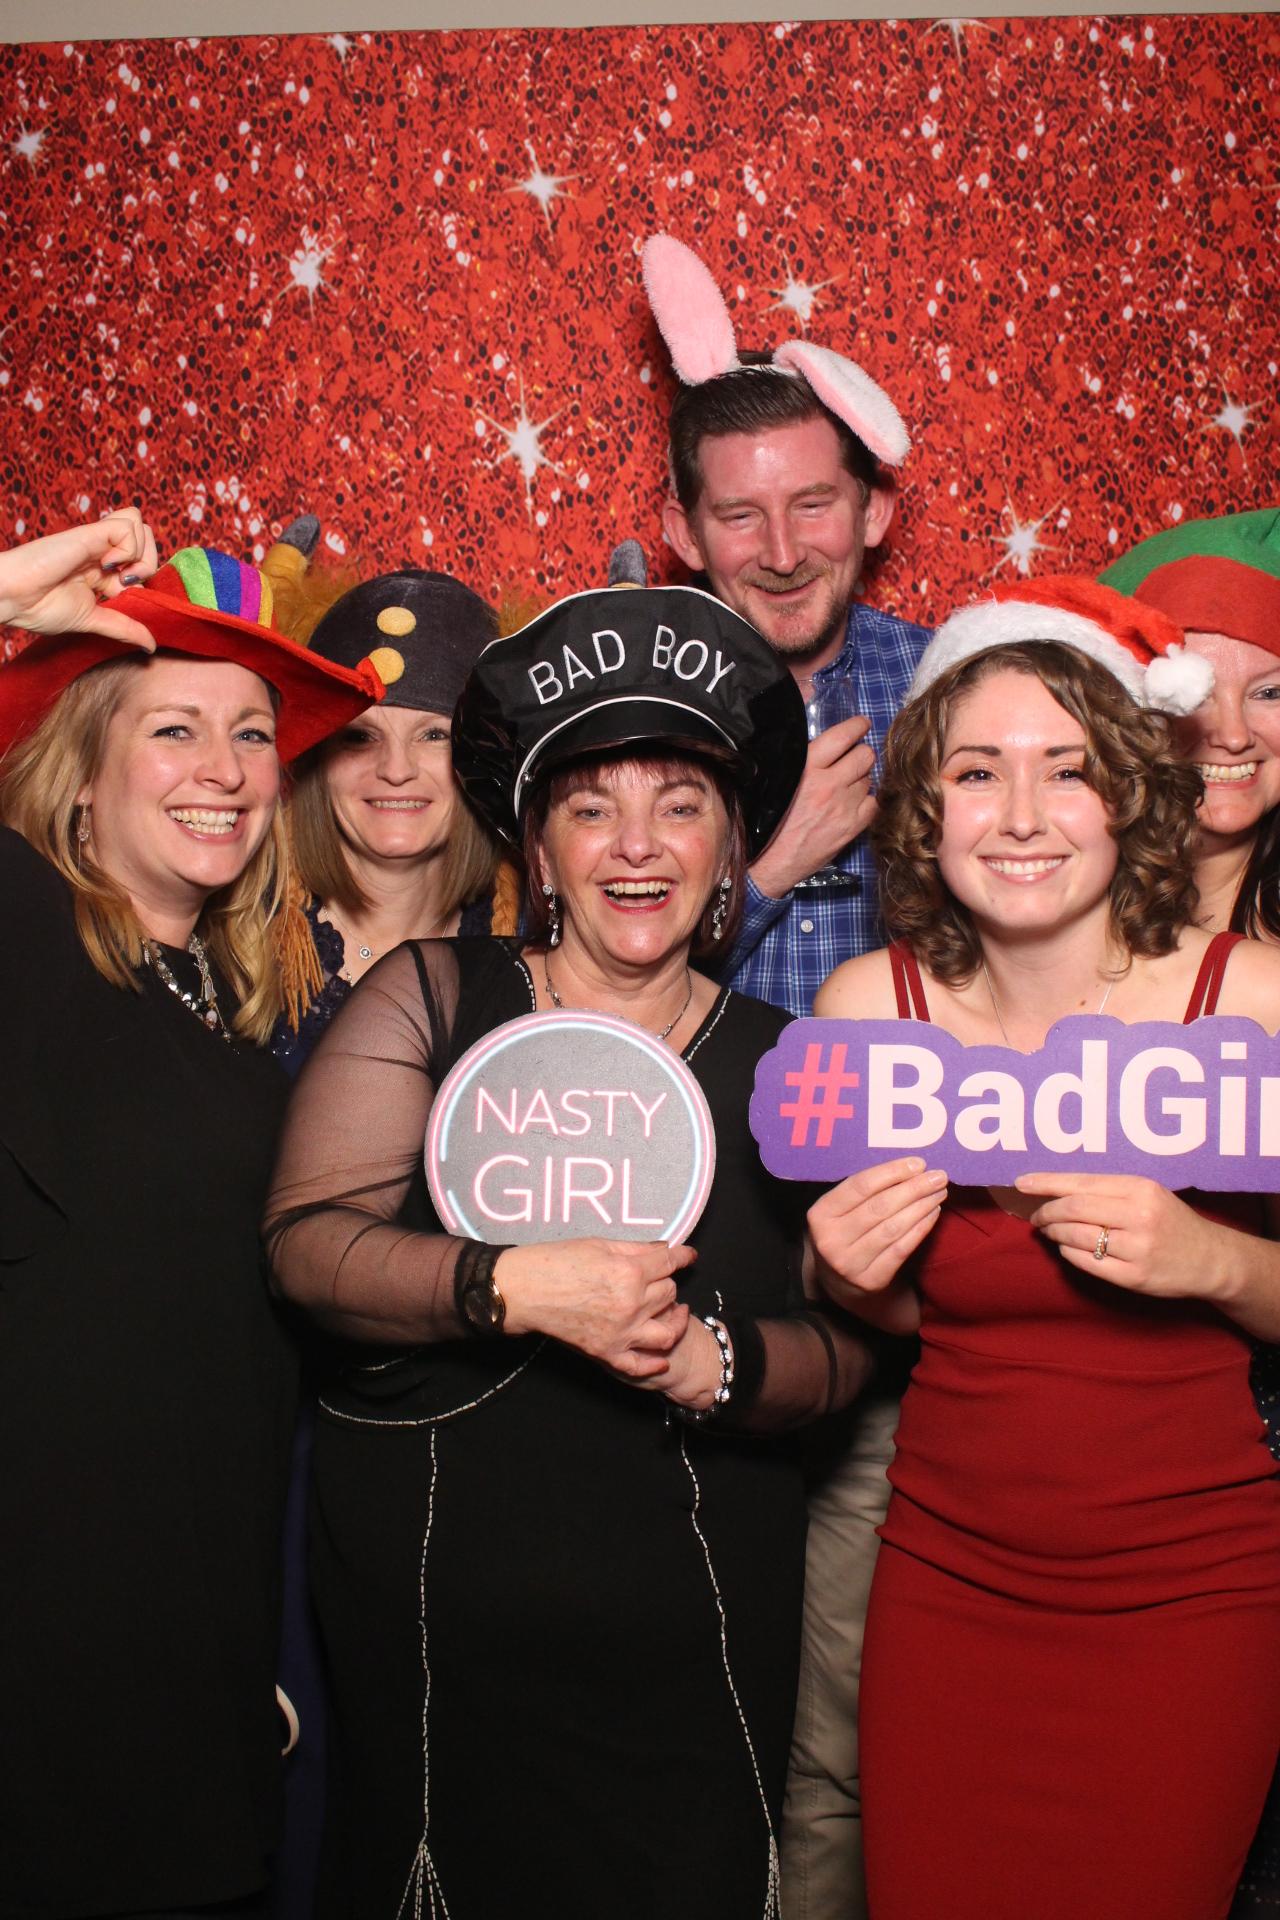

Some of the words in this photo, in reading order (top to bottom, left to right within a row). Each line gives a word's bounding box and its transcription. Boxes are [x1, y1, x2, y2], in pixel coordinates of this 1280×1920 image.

[527, 629, 626, 705] BAD
[652, 624, 737, 694] BOY
[474, 1086, 668, 1138] NASTY
[473, 1153, 665, 1225] GIRL
